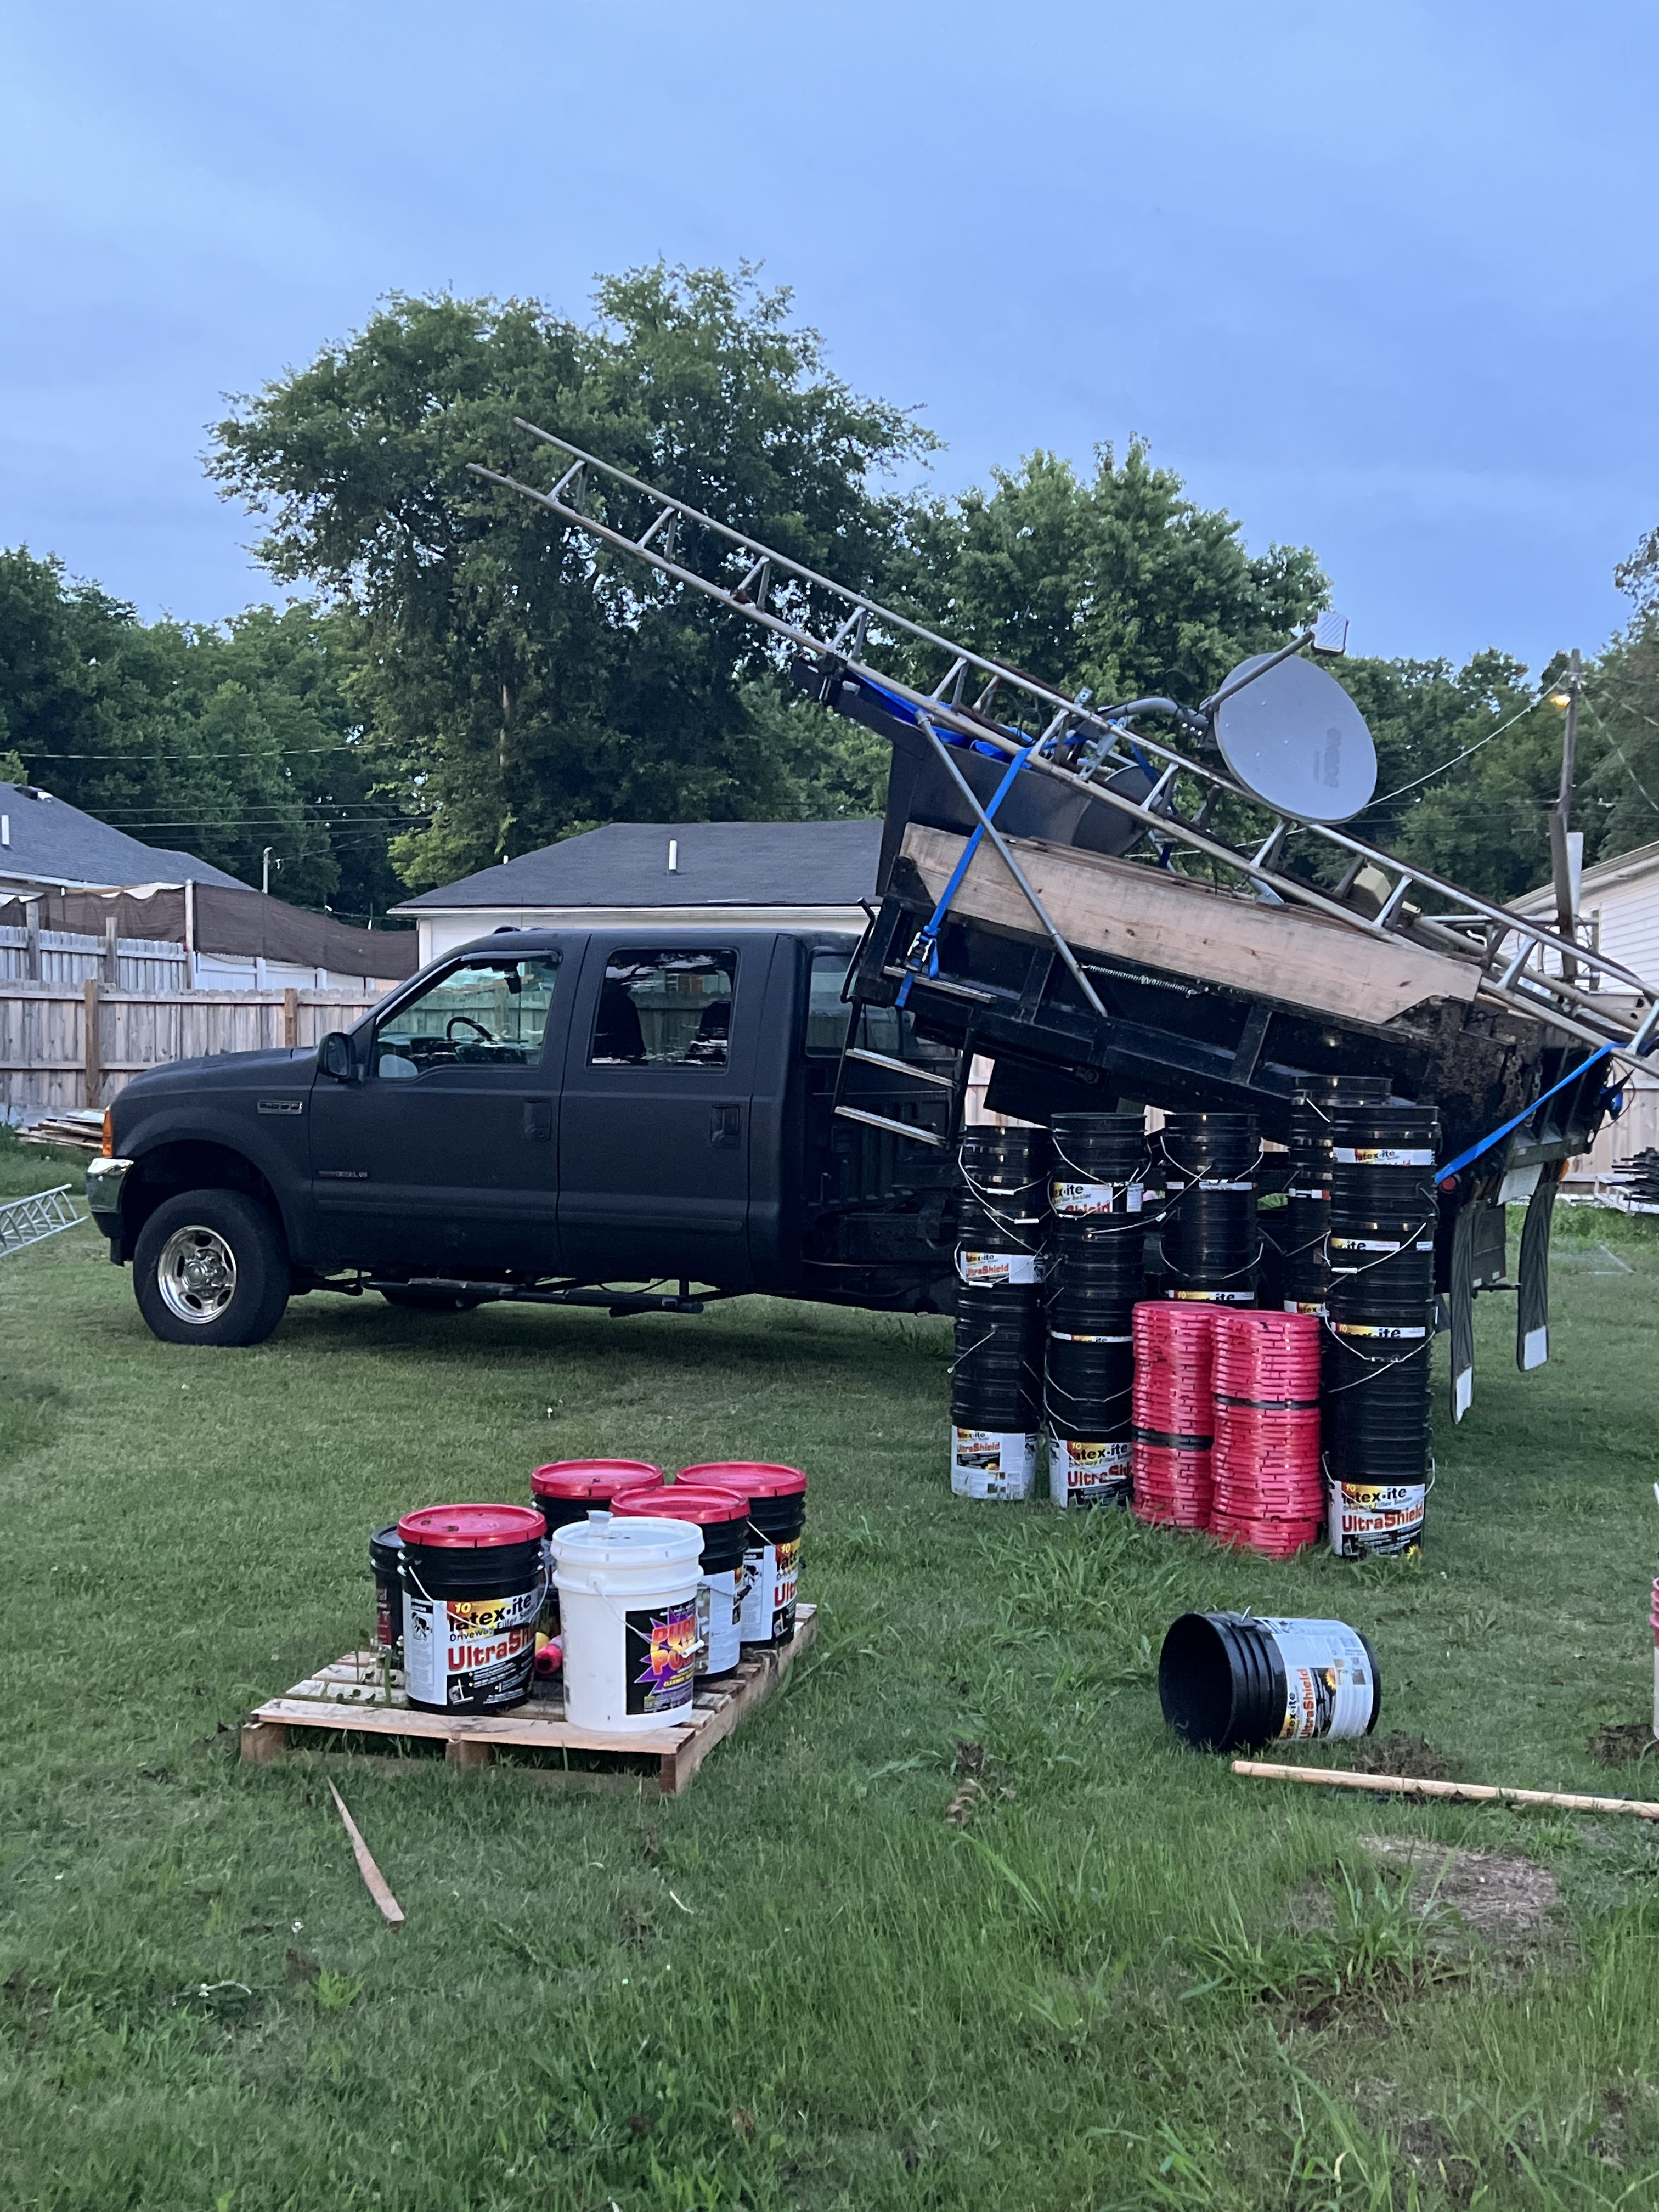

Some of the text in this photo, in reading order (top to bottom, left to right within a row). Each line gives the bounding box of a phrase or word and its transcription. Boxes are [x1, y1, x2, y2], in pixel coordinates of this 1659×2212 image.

[1346, 1483, 1356, 1492] 10
[1342, 1502, 1423, 1533] UltraShield
[781, 1543, 791, 1554] 10
[455, 1602, 472, 1613] 10
